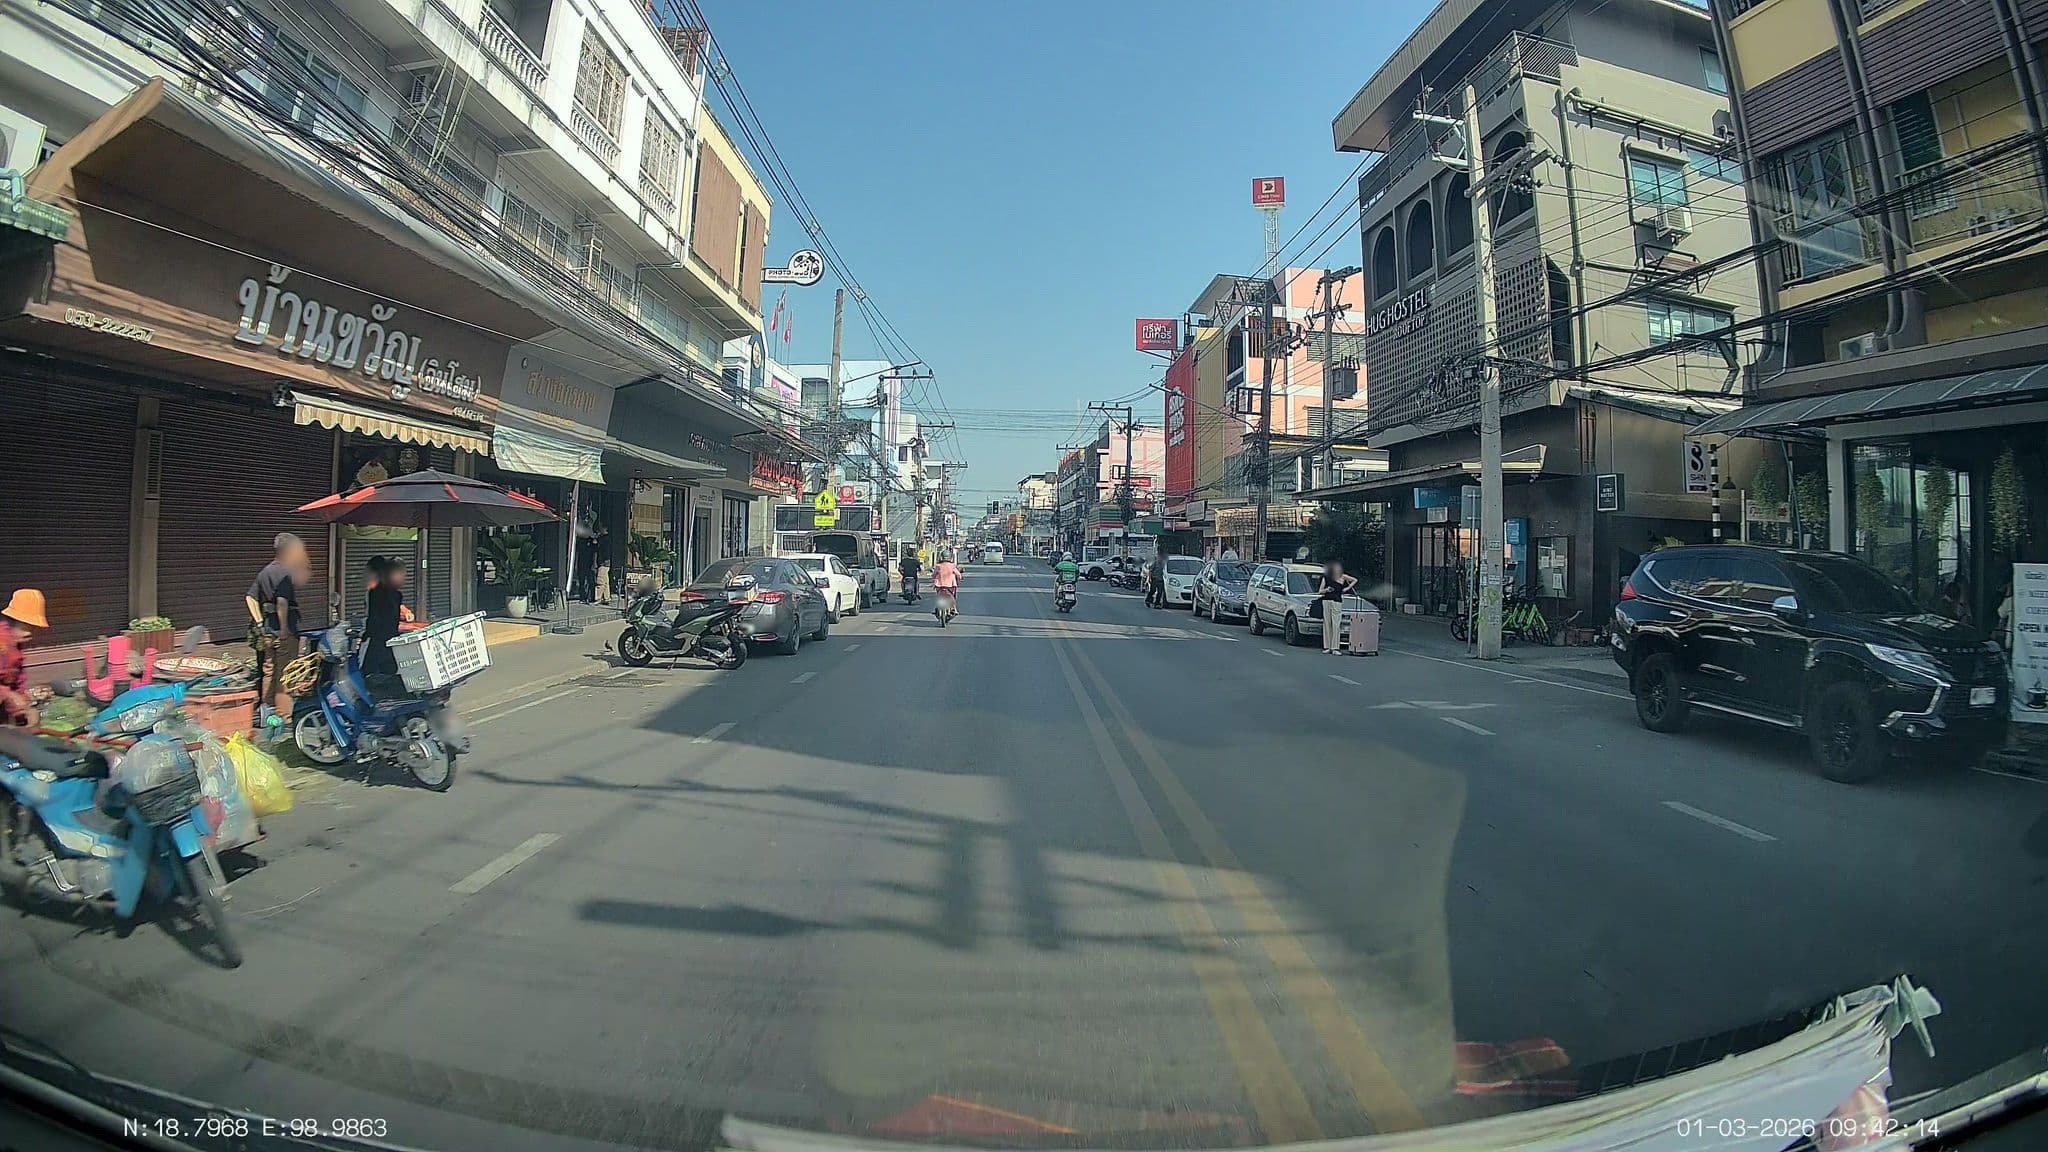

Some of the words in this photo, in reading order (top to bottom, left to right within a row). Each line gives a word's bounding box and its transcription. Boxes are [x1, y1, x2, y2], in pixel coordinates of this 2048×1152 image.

[234, 264, 421, 400] บ้านขวัญ
[1366, 310, 1386, 337] HUG
[1387, 288, 1428, 326] HOSTEL
